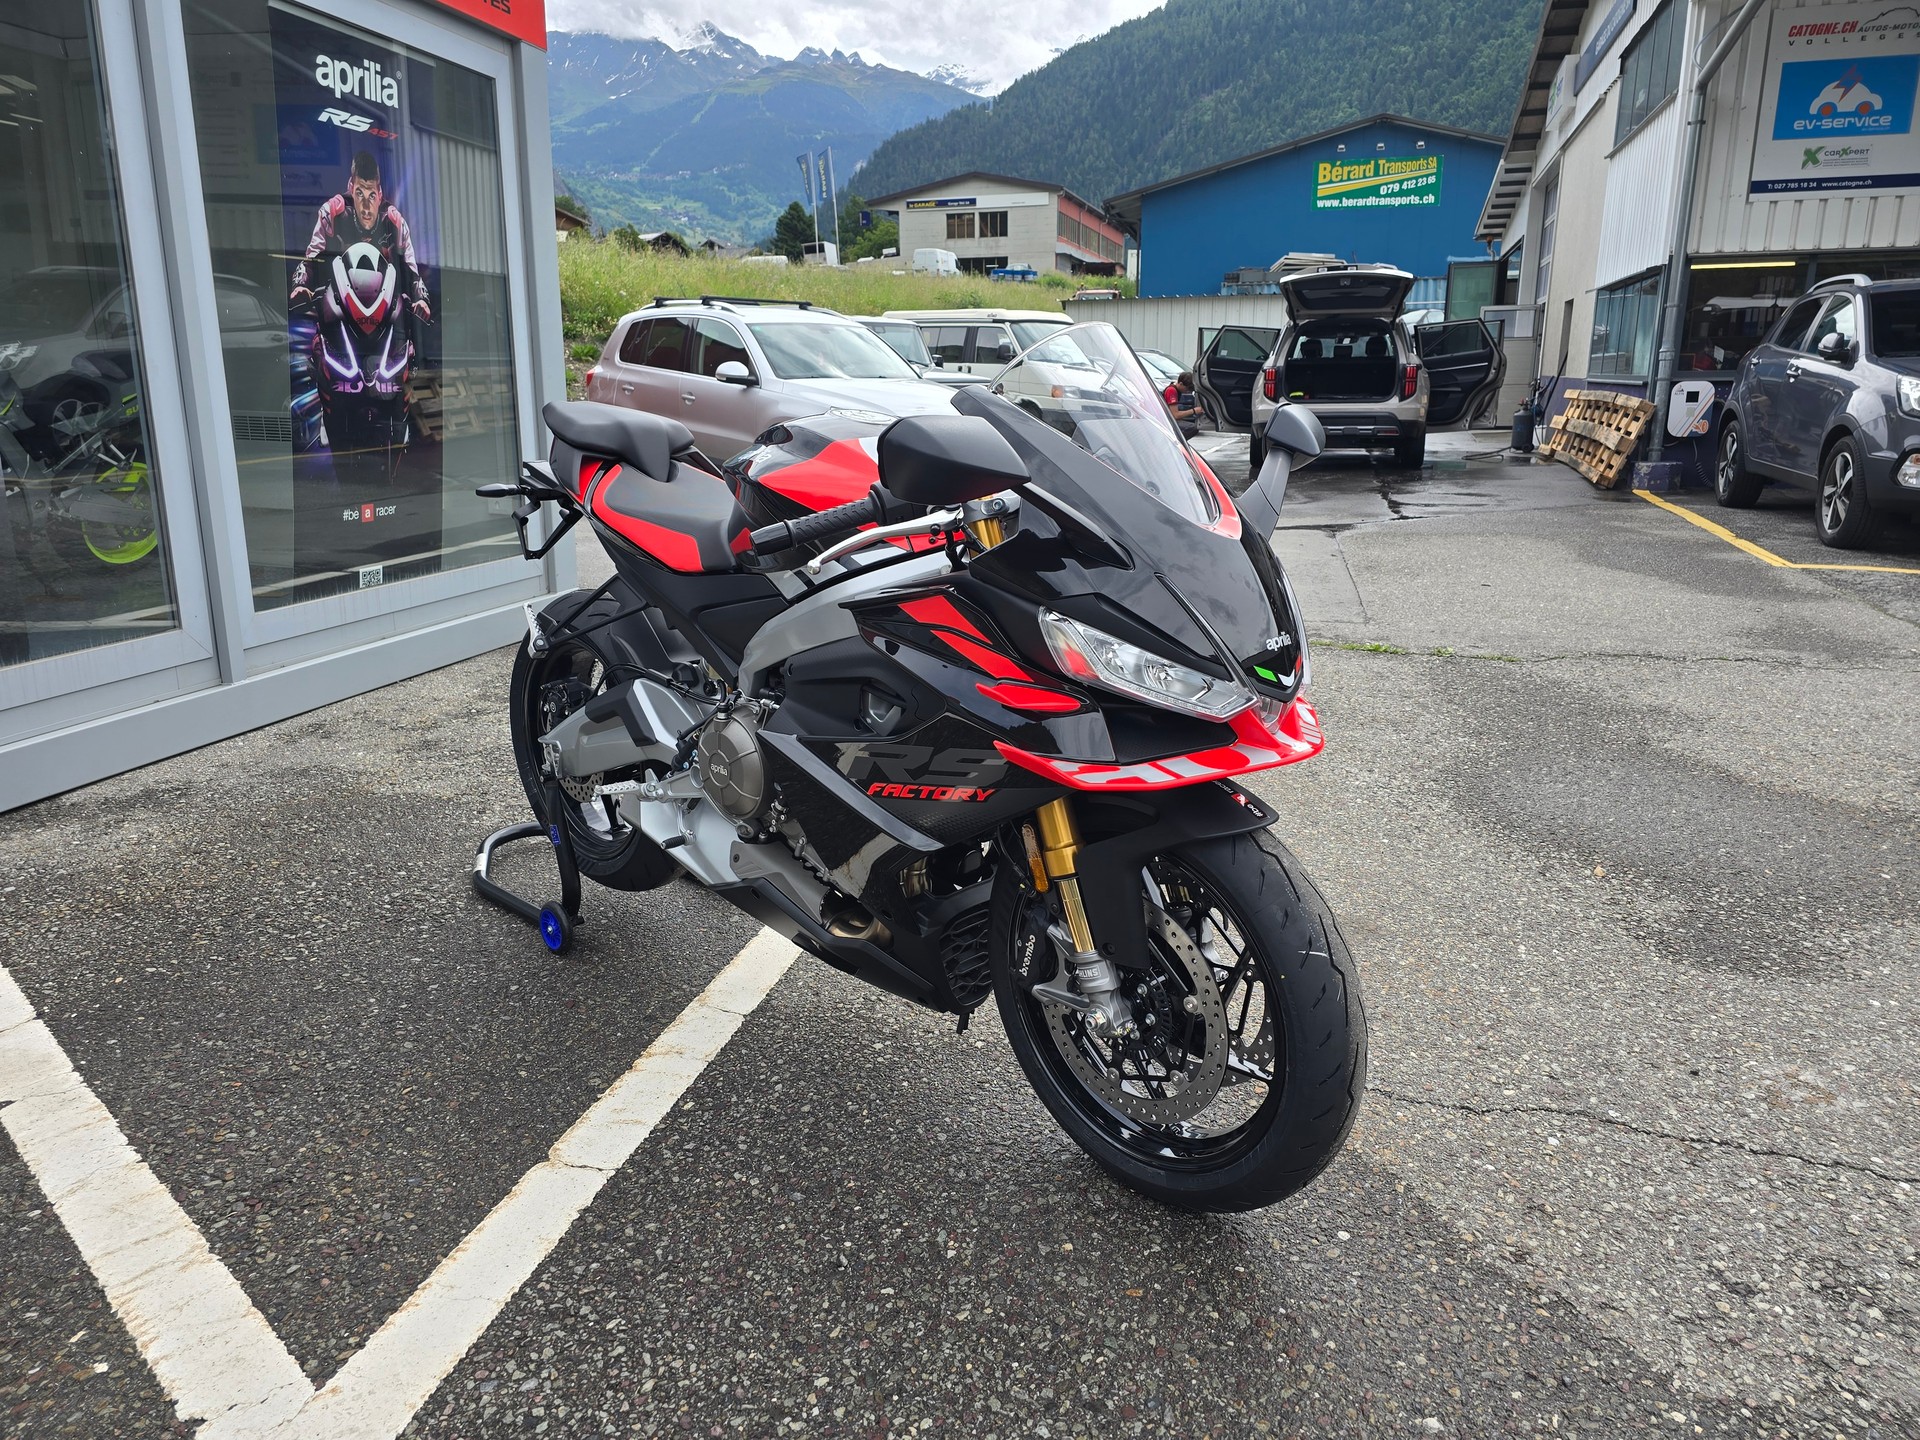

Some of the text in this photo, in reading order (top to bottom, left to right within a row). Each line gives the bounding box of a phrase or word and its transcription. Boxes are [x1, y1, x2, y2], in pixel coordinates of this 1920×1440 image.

[1788, 20, 1920, 38] CATOGNE.CH AUTOS-MOTO
[315, 54, 399, 109] aprilia
[317, 107, 399, 140] RS 457
[1793, 115, 1892, 130] ev-service
[1318, 156, 1437, 184] Bérard Transports SA
[1380, 175, 1436, 195] 079 412 23 65
[1821, 179, 1873, 188] www.catogne.ch
[914, 200, 937, 208] GARAGE
[1317, 194, 1435, 207] www.berardtransports.ch
[343, 508, 360, 521] #be
[376, 505, 396, 517] racer
[710, 763, 728, 776] aprilia
[846, 744, 1010, 787] RS
[867, 782, 996, 801] FACTORY
[1019, 934, 1036, 977] brembo
